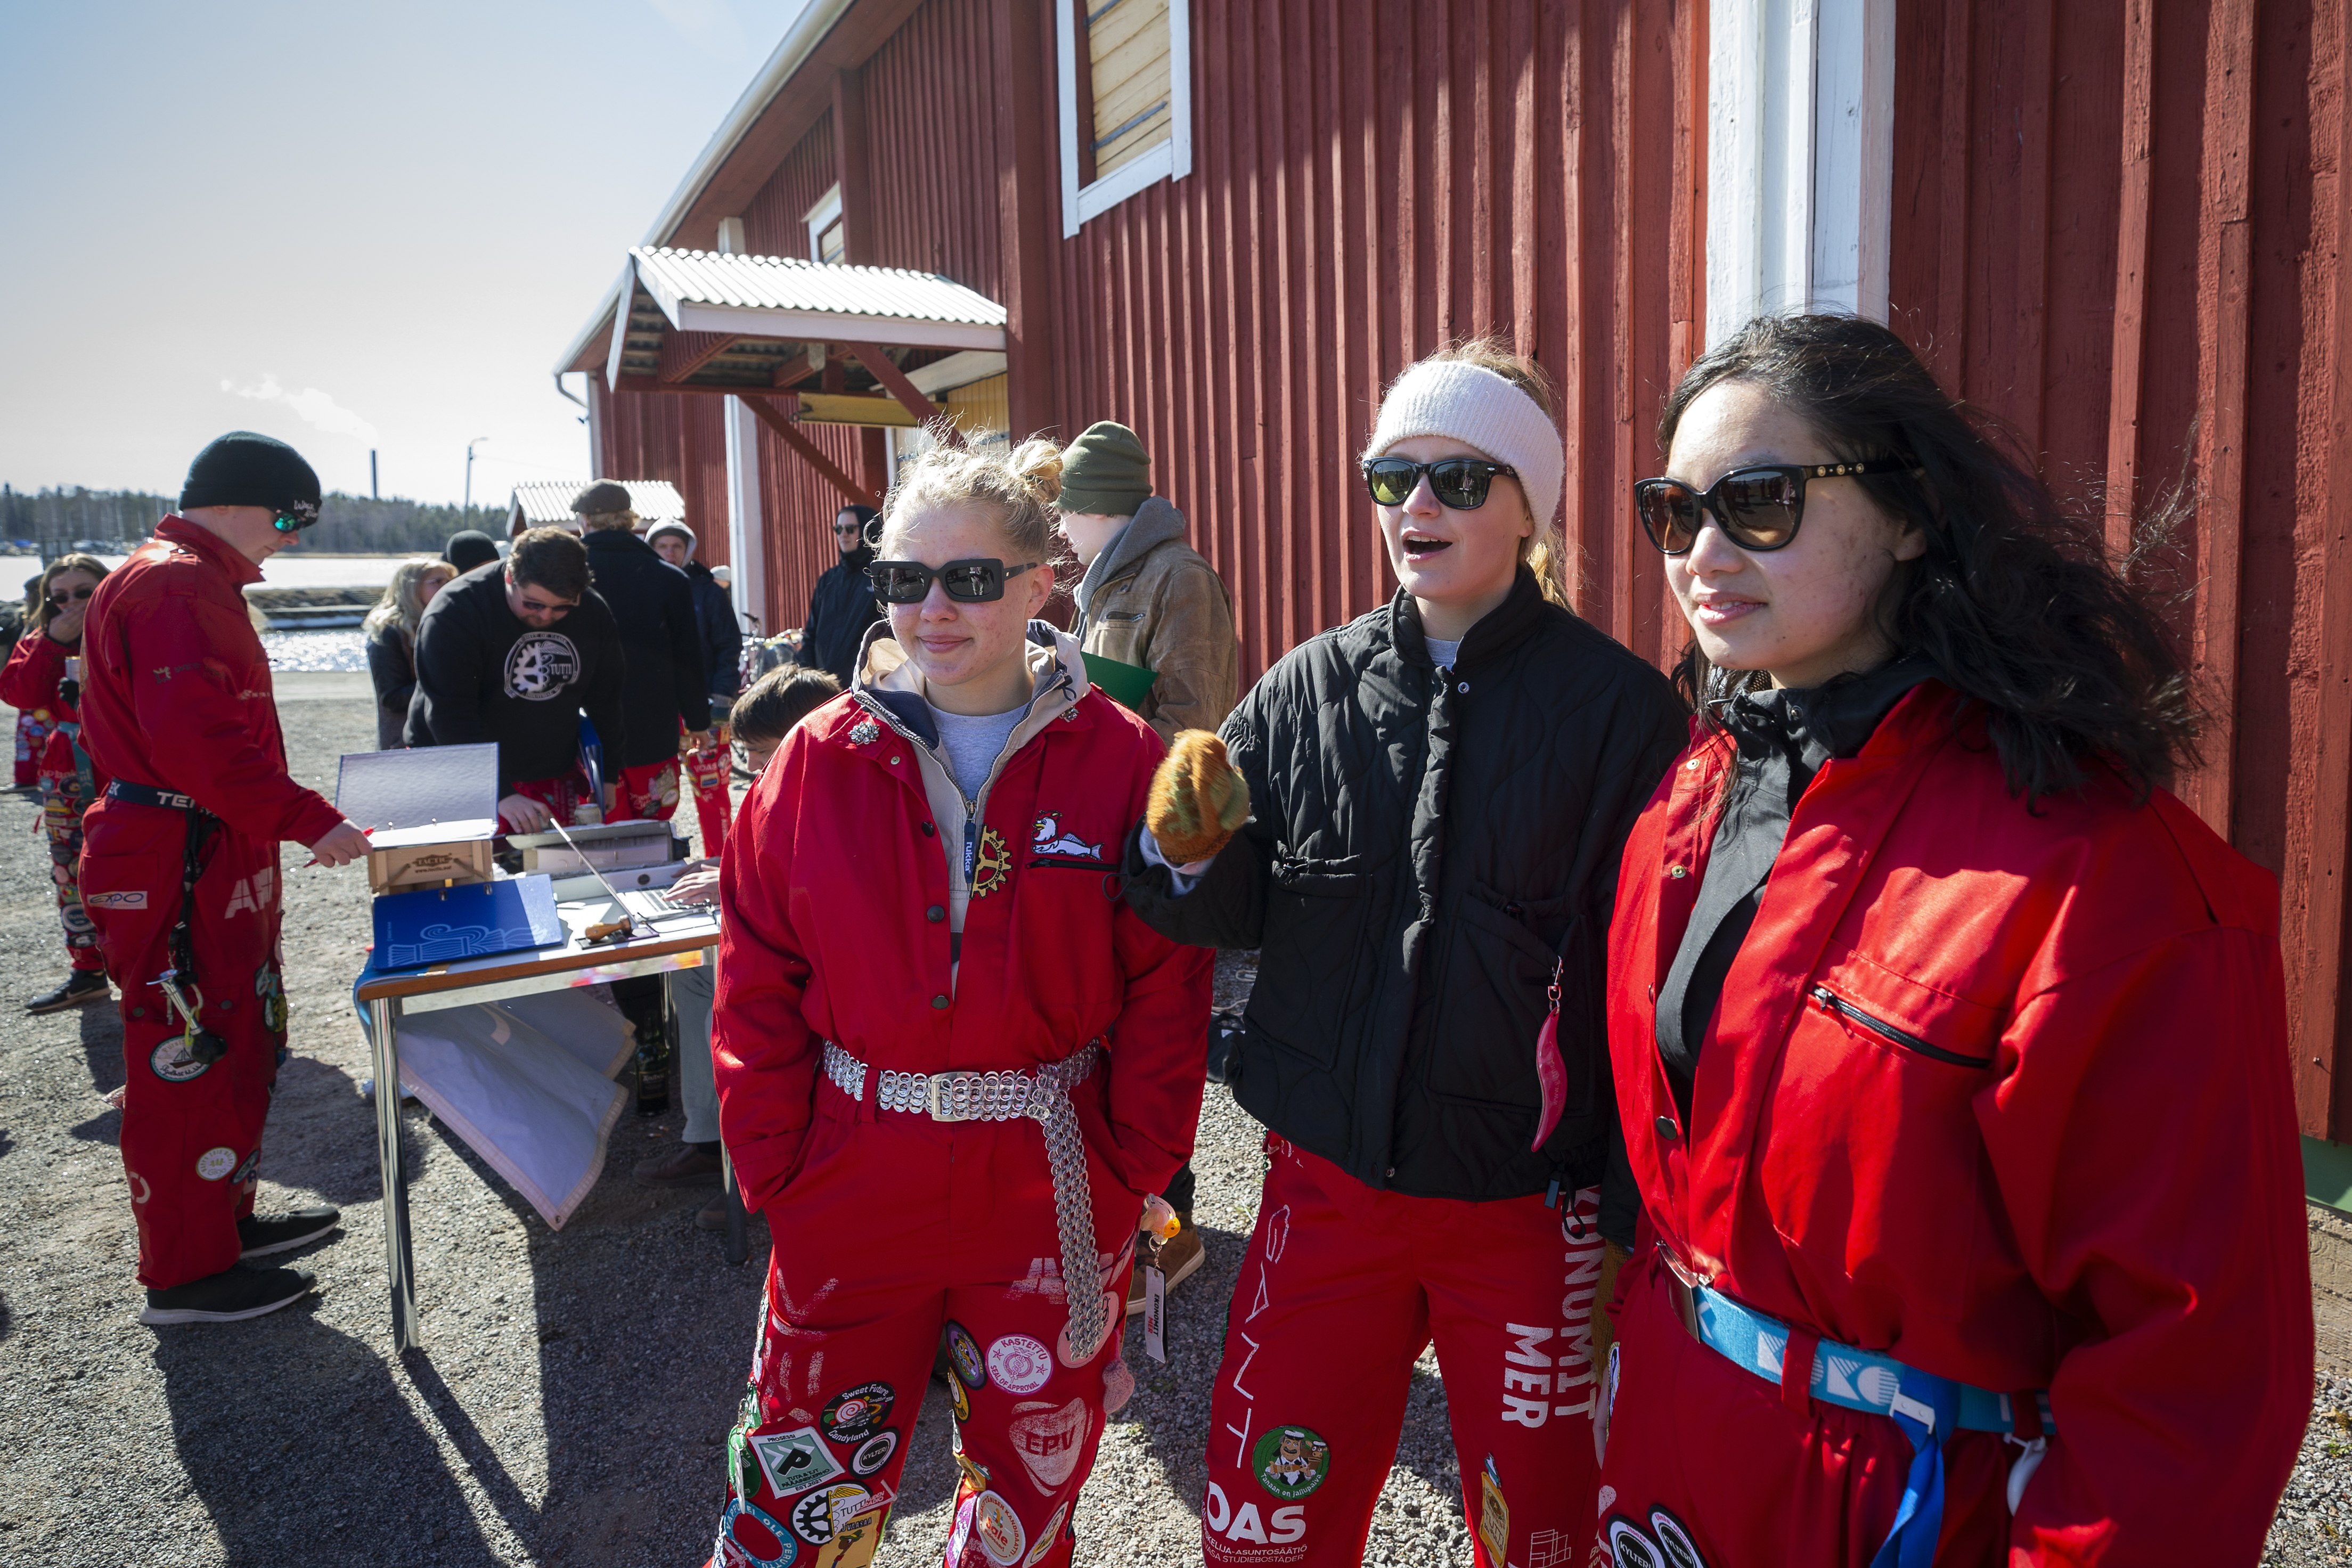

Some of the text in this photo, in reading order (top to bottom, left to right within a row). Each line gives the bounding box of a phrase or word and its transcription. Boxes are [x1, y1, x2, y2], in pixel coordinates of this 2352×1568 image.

[549, 663, 572, 675] TUTTI
[90, 893, 144, 906] EXPO
[1001, 1338, 1048, 1360] KASTETTU
[990, 1365, 1002, 1381] SEAL
[1007, 1381, 1040, 1392] APPROVAL
[1502, 1322, 1554, 1428] MER
[842, 1386, 869, 1400] Sweet
[869, 1384, 889, 1396] Future
[767, 1434, 796, 1442] PROSESSI
[828, 1429, 869, 1443] Candyland
[1026, 1425, 1076, 1456] EPV
[862, 1446, 888, 1461] KYLTERI
[781, 1468, 830, 1488] PÄÄAINEKERHO
[840, 1499, 868, 1517] TUTTI
[747, 1506, 755, 1515] EI
[763, 1518, 784, 1538] OLE
[847, 1516, 872, 1531] VAASAA
[986, 1516, 1008, 1546] Sale
[1620, 1540, 1652, 1568] KYLTERI
[1662, 1532, 1693, 1565] KYLTERI
[1222, 1554, 1304, 1564] STUDIEBOSTÄDER
